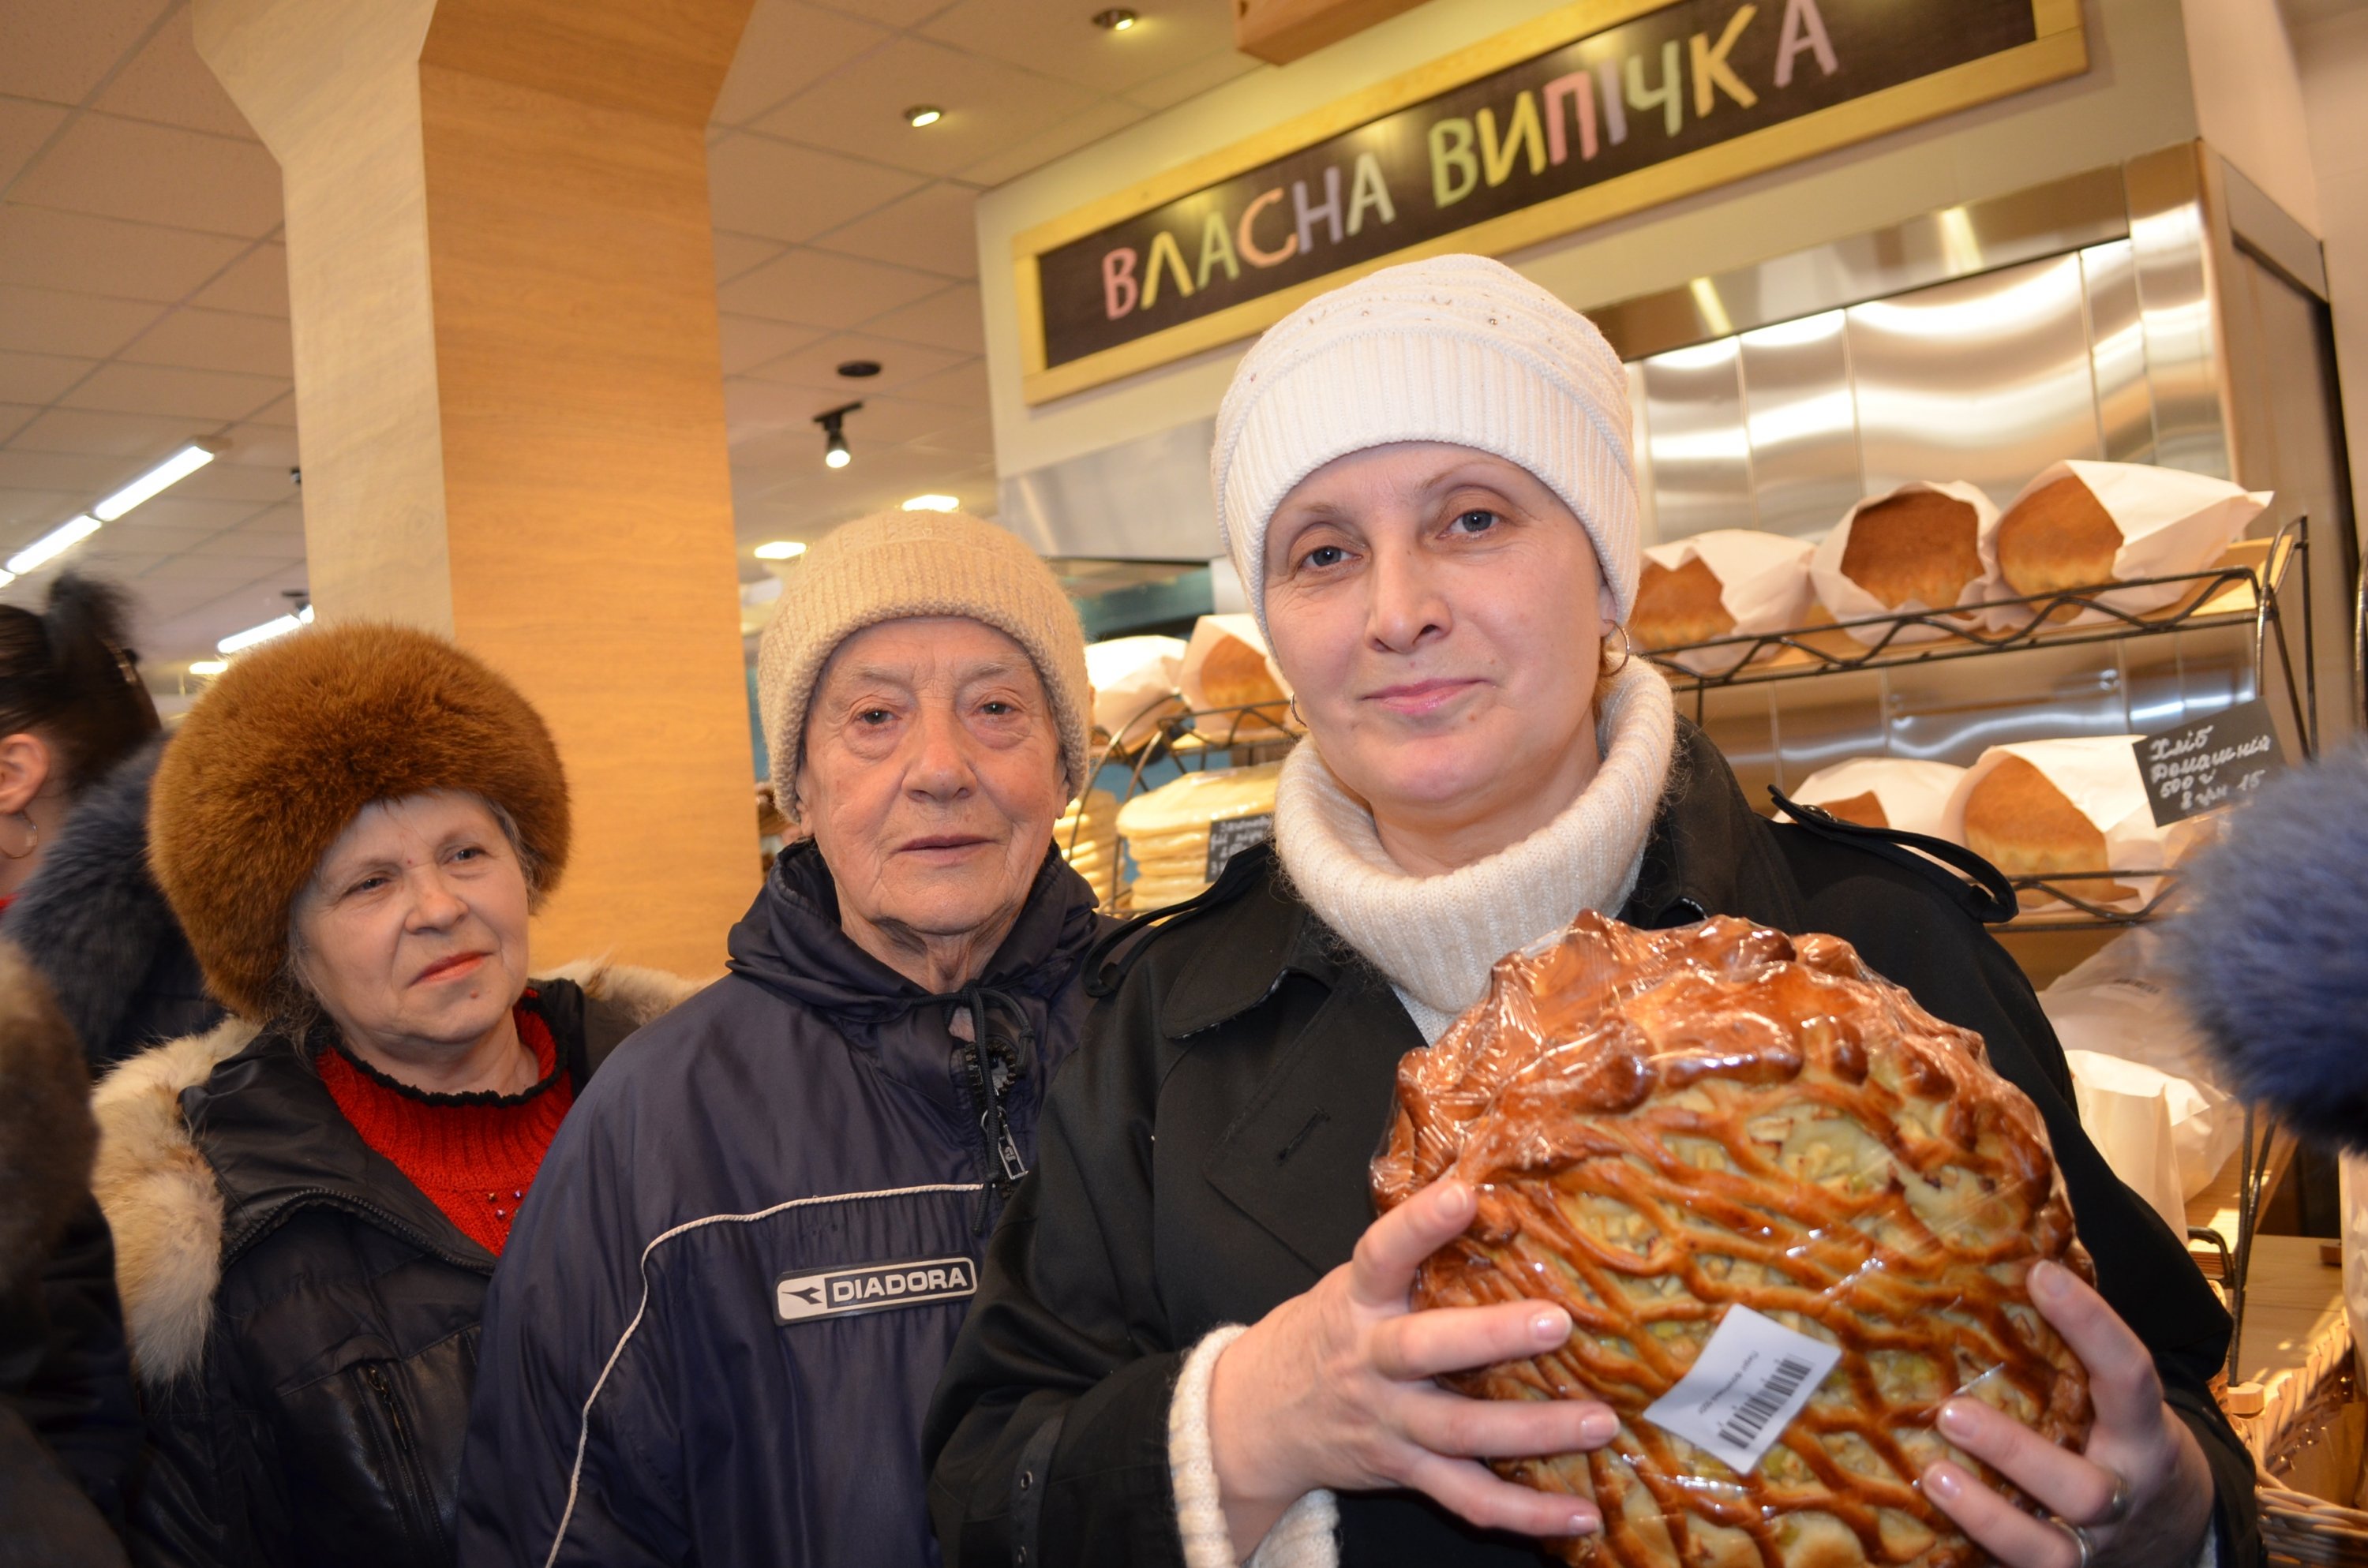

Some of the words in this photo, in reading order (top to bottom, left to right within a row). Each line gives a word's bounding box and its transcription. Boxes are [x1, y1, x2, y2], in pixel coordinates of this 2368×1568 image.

[1102, 152, 1396, 321] ВЛАСНА
[1428, 0, 1839, 210] ВИПІЧКА
[2149, 724, 2214, 762] Хліб
[2160, 775, 2194, 799] 500
[832, 1267, 968, 1303] DIADORA
